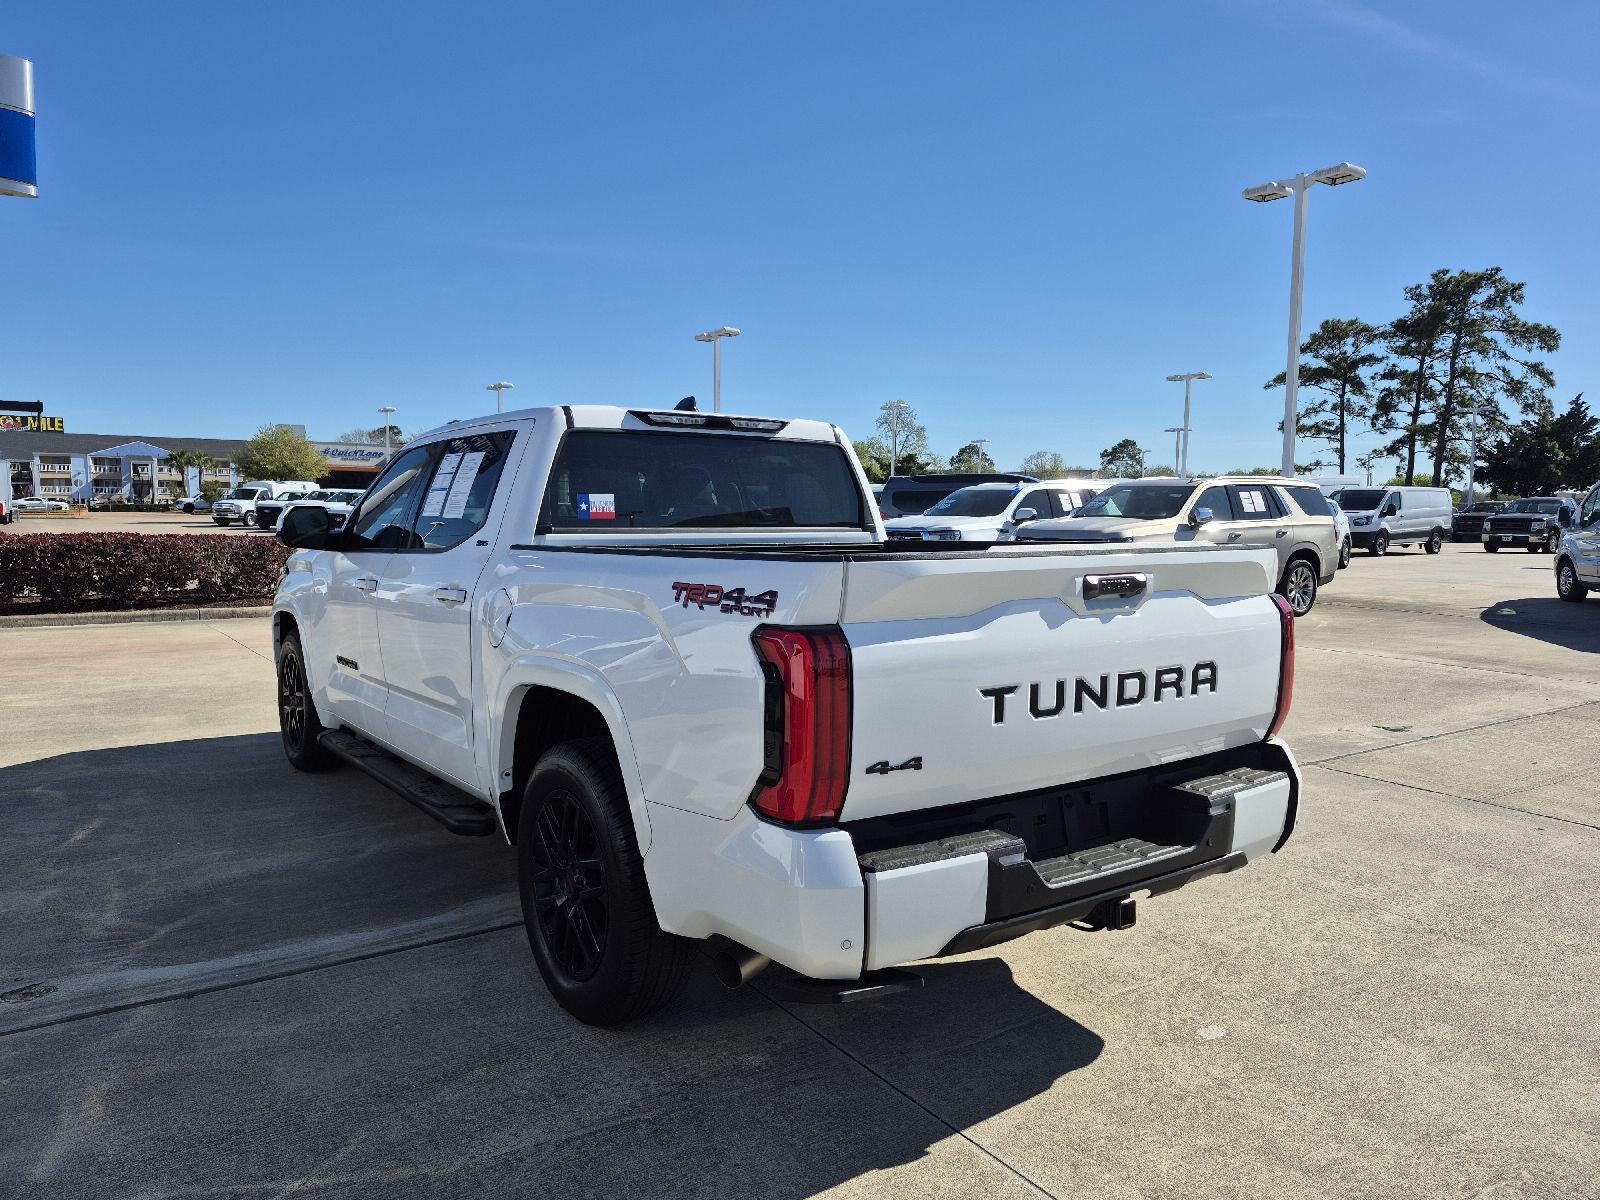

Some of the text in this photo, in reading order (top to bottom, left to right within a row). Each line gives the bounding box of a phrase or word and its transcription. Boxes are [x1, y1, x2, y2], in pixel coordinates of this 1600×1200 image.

[672, 582, 723, 610] TRD
[720, 603, 775, 618] SPORT
[977, 660, 1217, 726] TUNDRA
